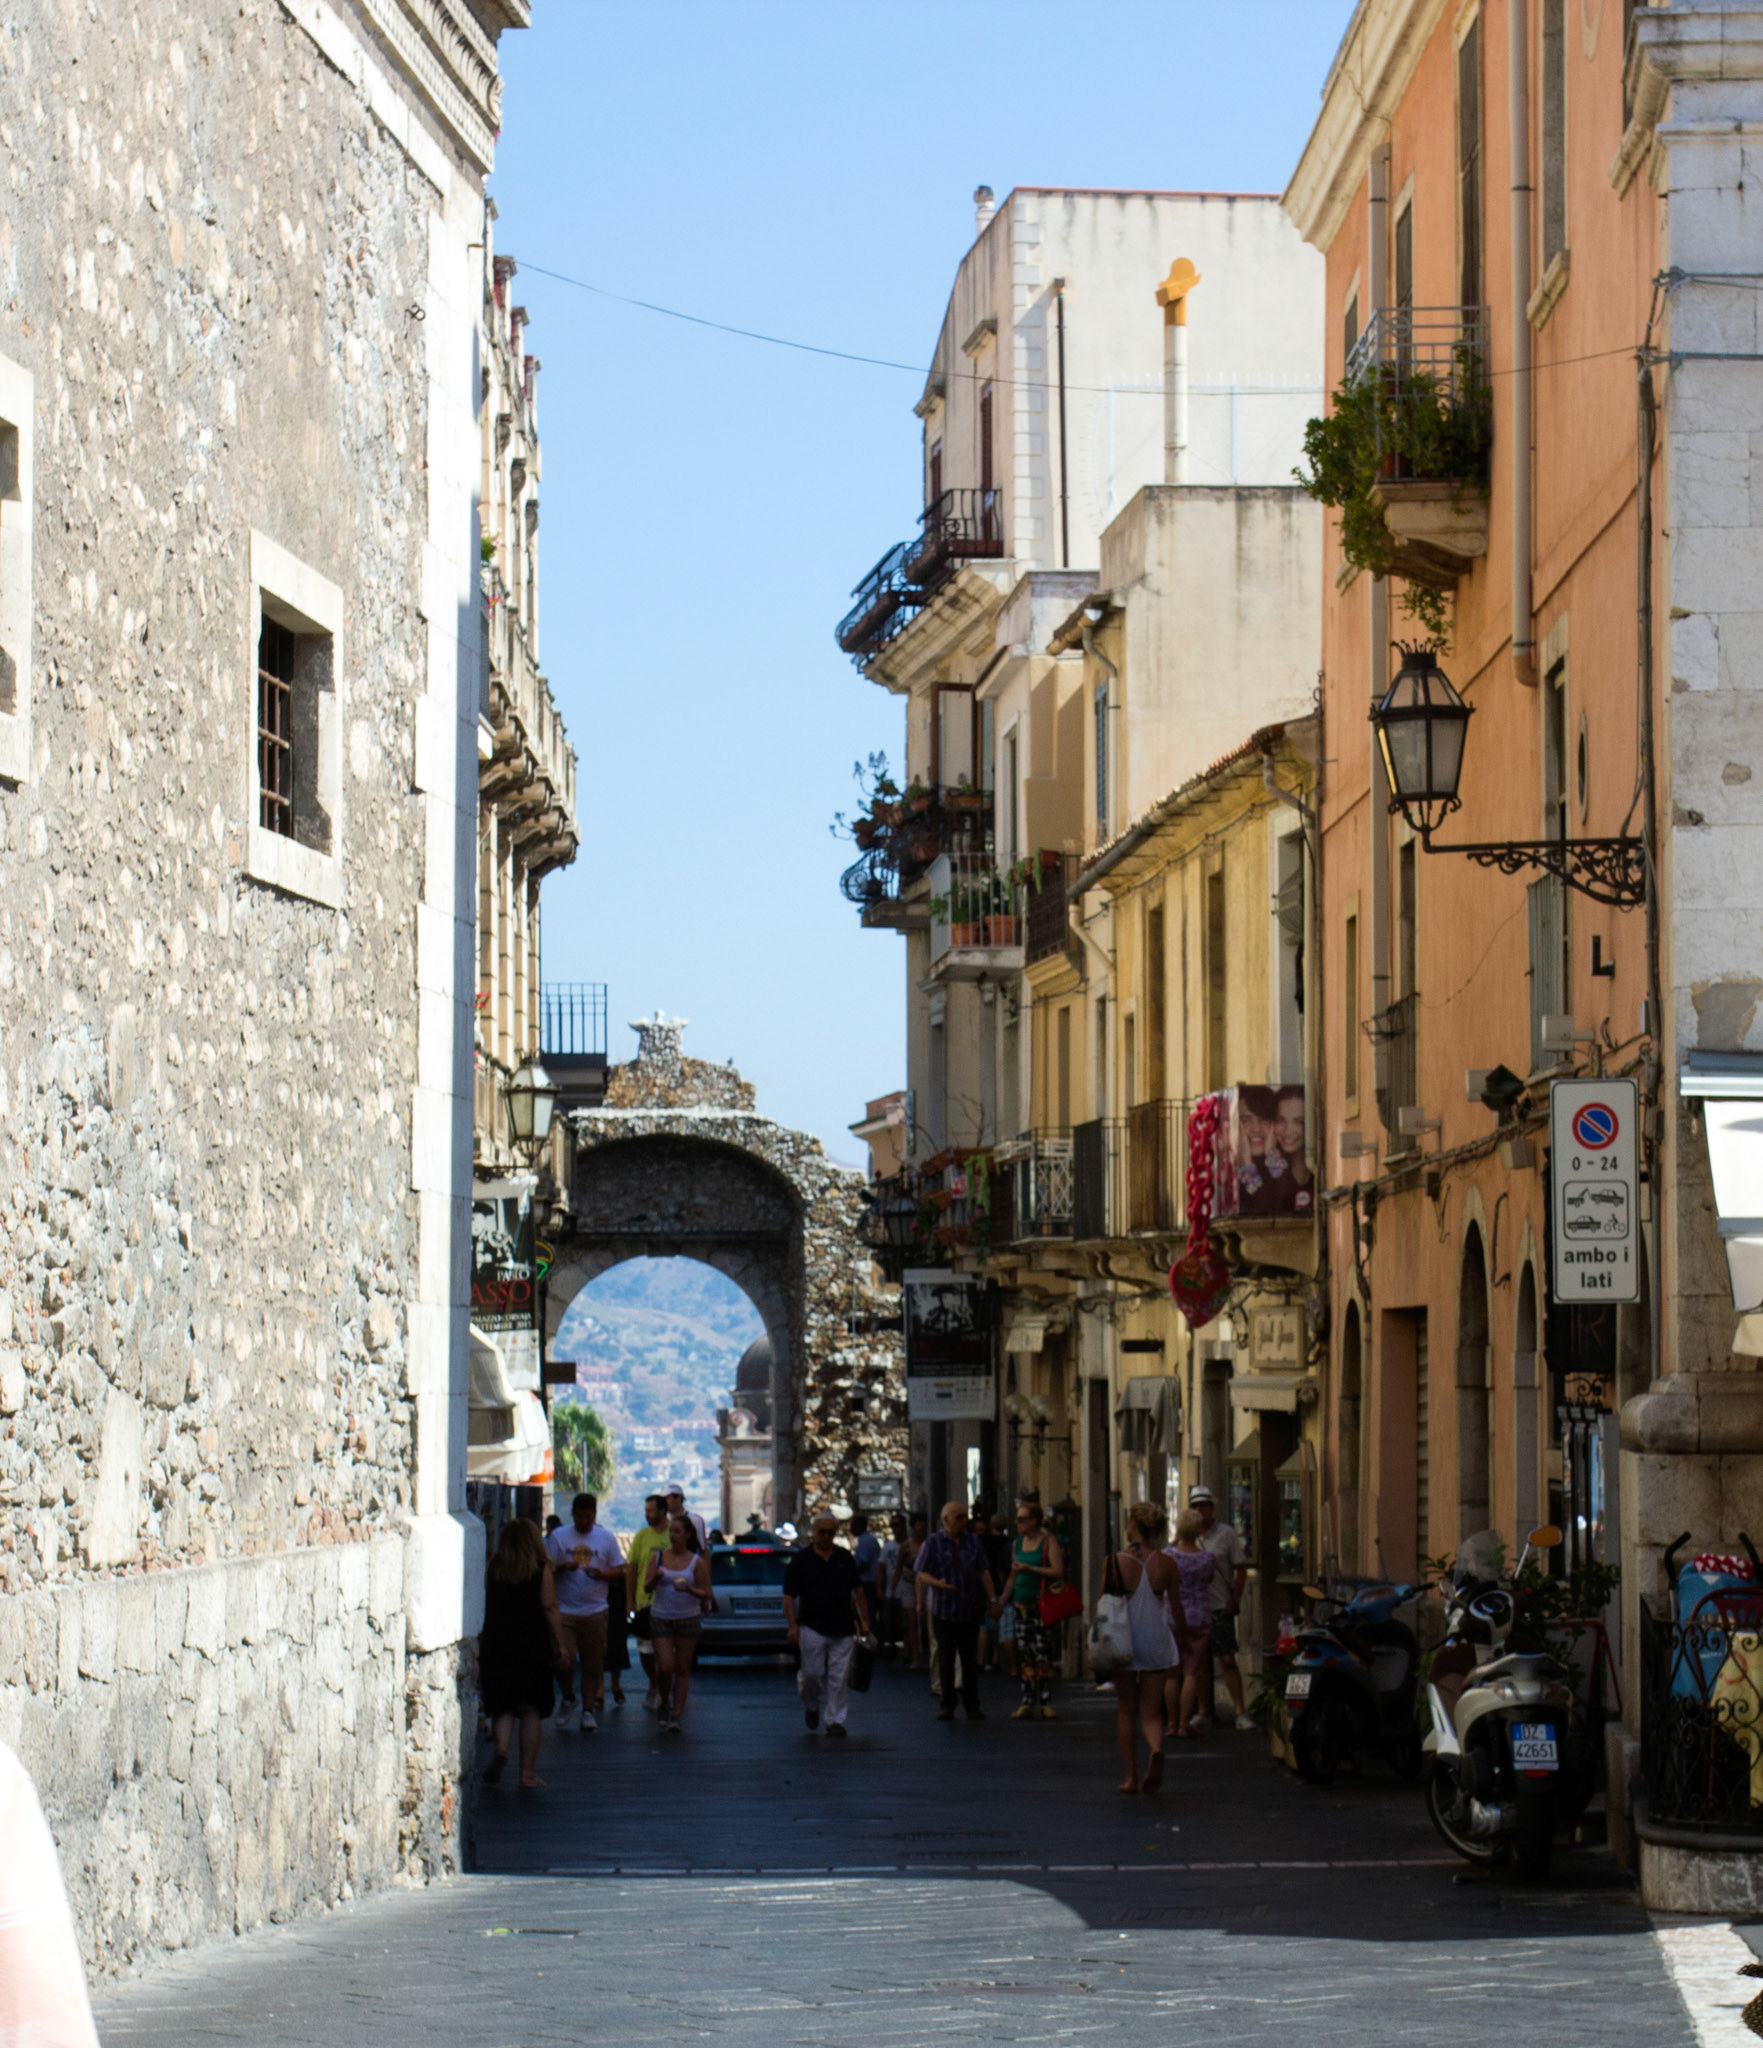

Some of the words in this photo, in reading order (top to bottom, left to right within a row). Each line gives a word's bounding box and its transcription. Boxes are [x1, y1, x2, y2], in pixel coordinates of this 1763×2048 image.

[1572, 1156, 1581, 1171] 0
[1600, 1156, 1618, 1171] 24
[1564, 1246, 1617, 1263] ambo
[1624, 1246, 1629, 1263] i
[1581, 1271, 1612, 1288] lati
